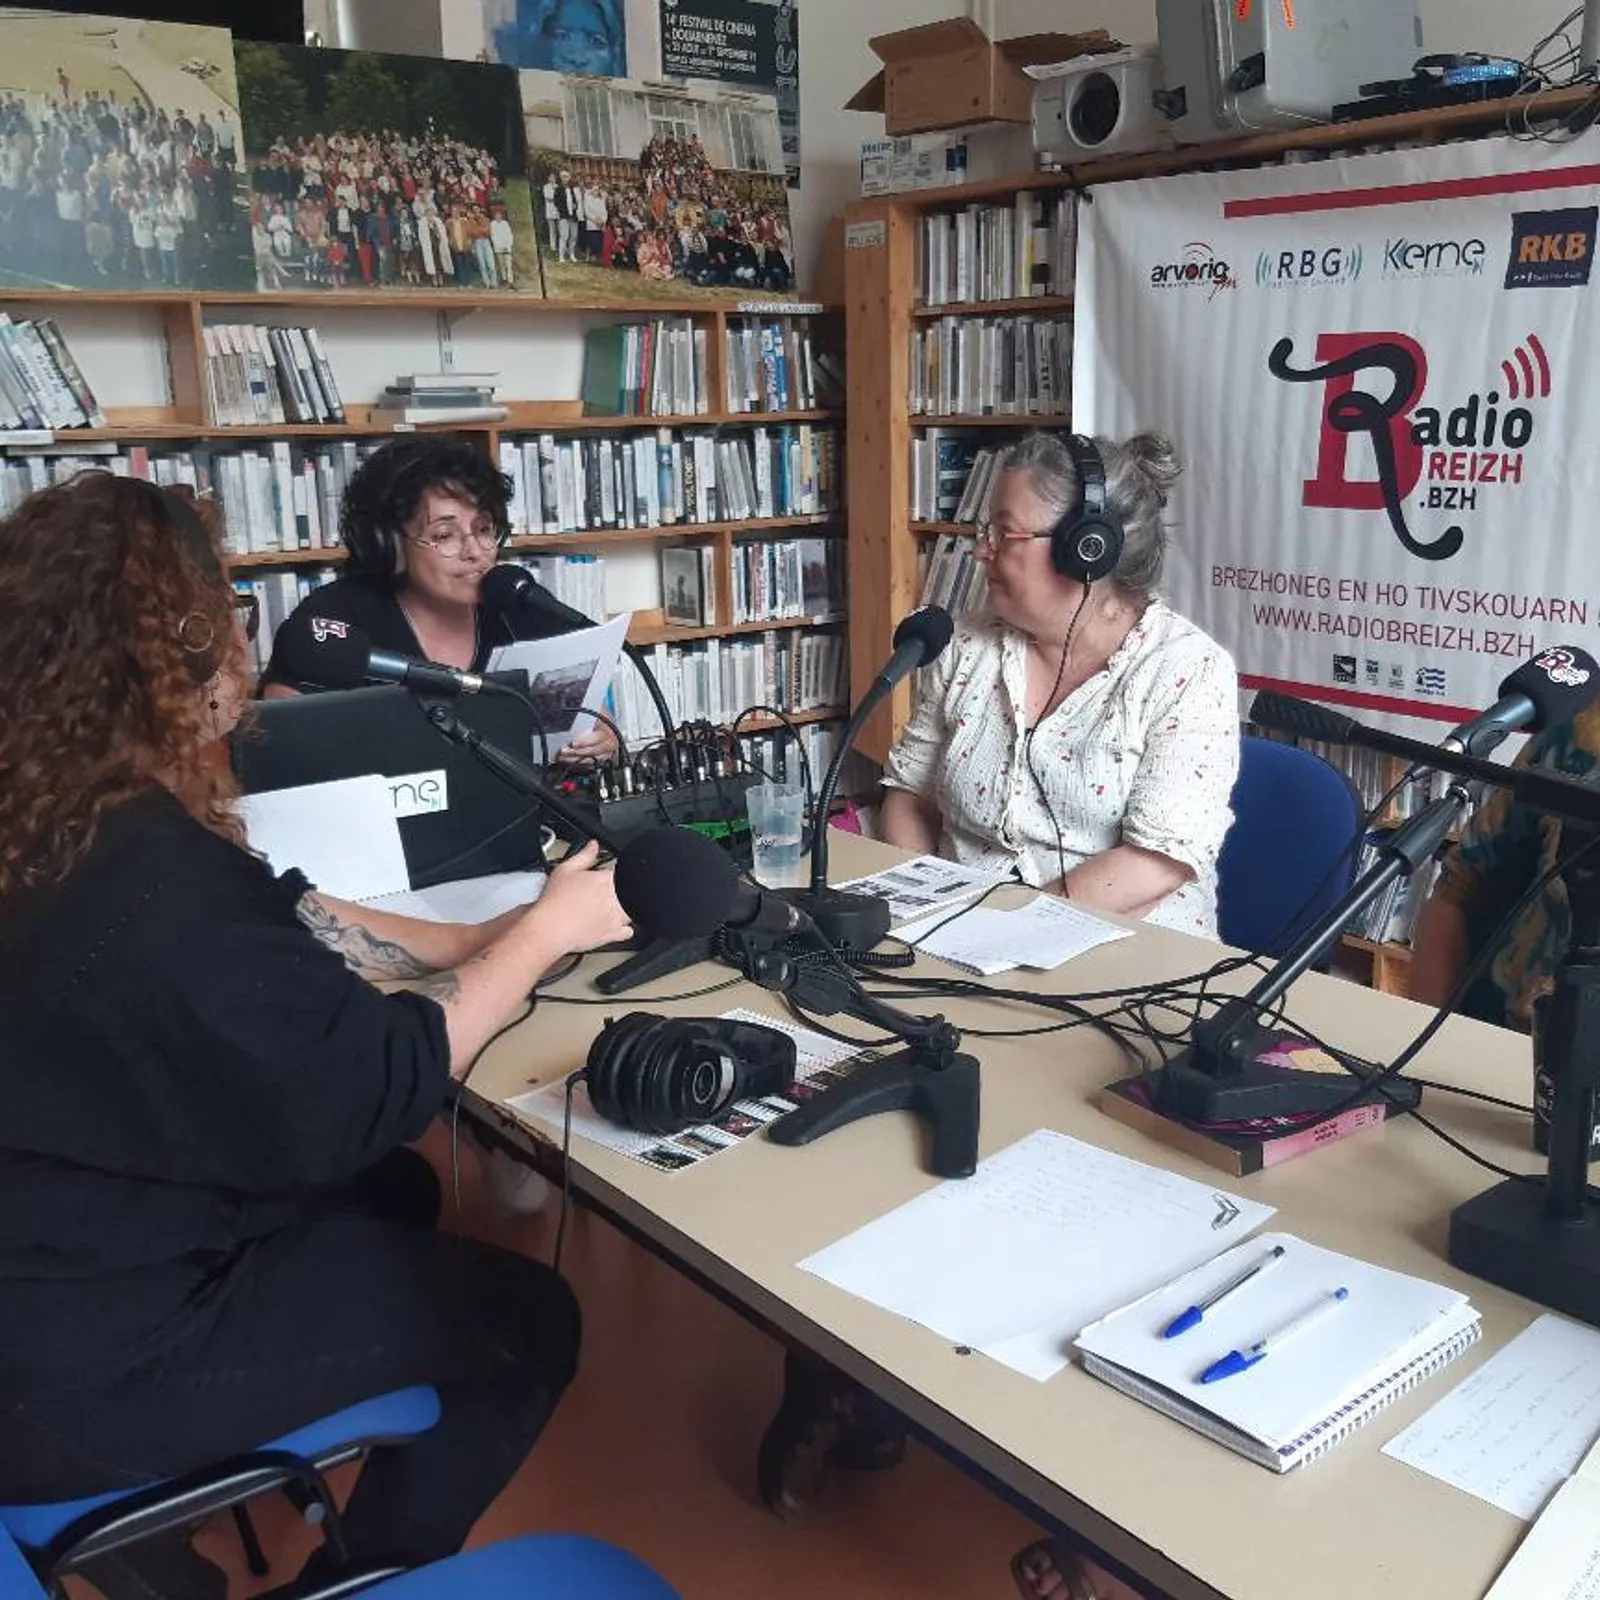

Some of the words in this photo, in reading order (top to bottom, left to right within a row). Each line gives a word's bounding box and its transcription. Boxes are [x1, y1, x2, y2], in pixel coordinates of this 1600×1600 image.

[680, 15, 713, 31] FESTIVAL
[714, 19, 725, 33] DE
[1519, 231, 1587, 263] RKB
[1277, 247, 1342, 280] RBG
[1419, 487, 1477, 510] .BZH
[1211, 565, 1331, 599] BREZHONEG
[1338, 579, 1368, 603] EN
[1375, 583, 1408, 607] HO
[1415, 586, 1587, 625] TIVSKOUARN
[1253, 604, 1535, 659] WWW.RADIOBREIZH.BZH
